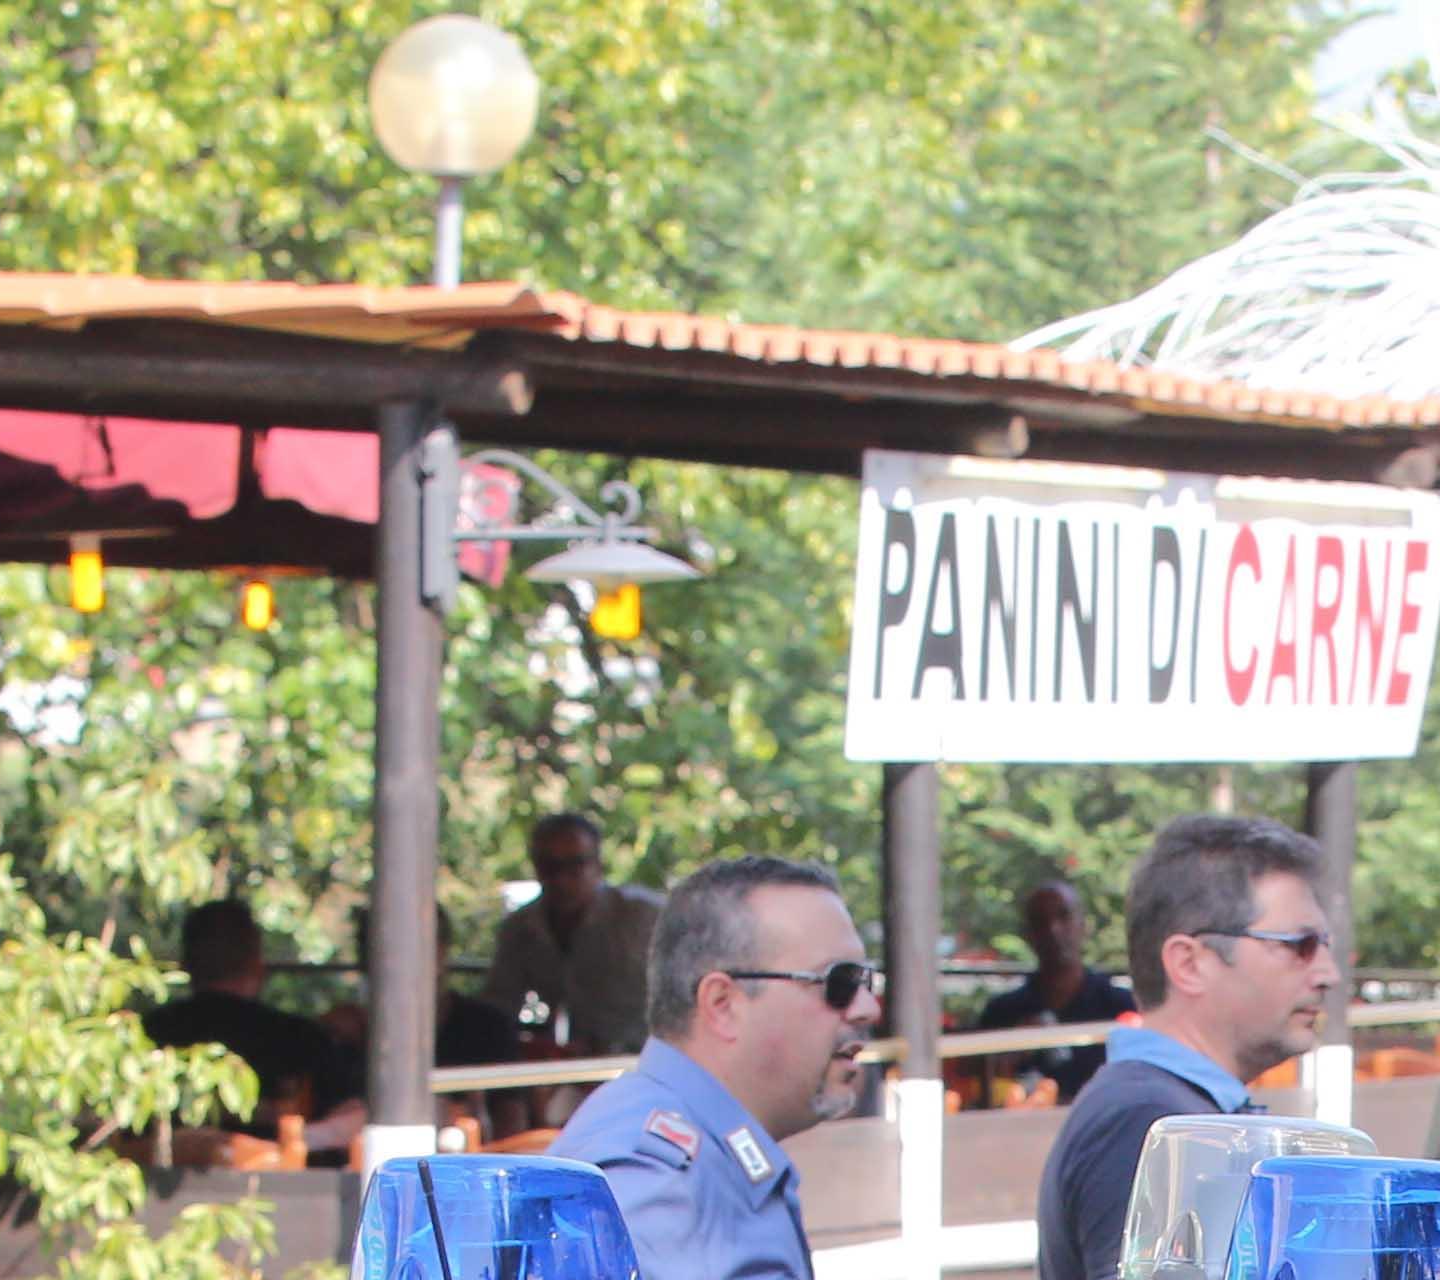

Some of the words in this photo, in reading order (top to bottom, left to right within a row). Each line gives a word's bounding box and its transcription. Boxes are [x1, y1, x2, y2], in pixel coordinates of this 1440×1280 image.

[872, 506, 1120, 704] PANINI
[1148, 525, 1208, 705] DI
[1222, 522, 1430, 707] CARNE
